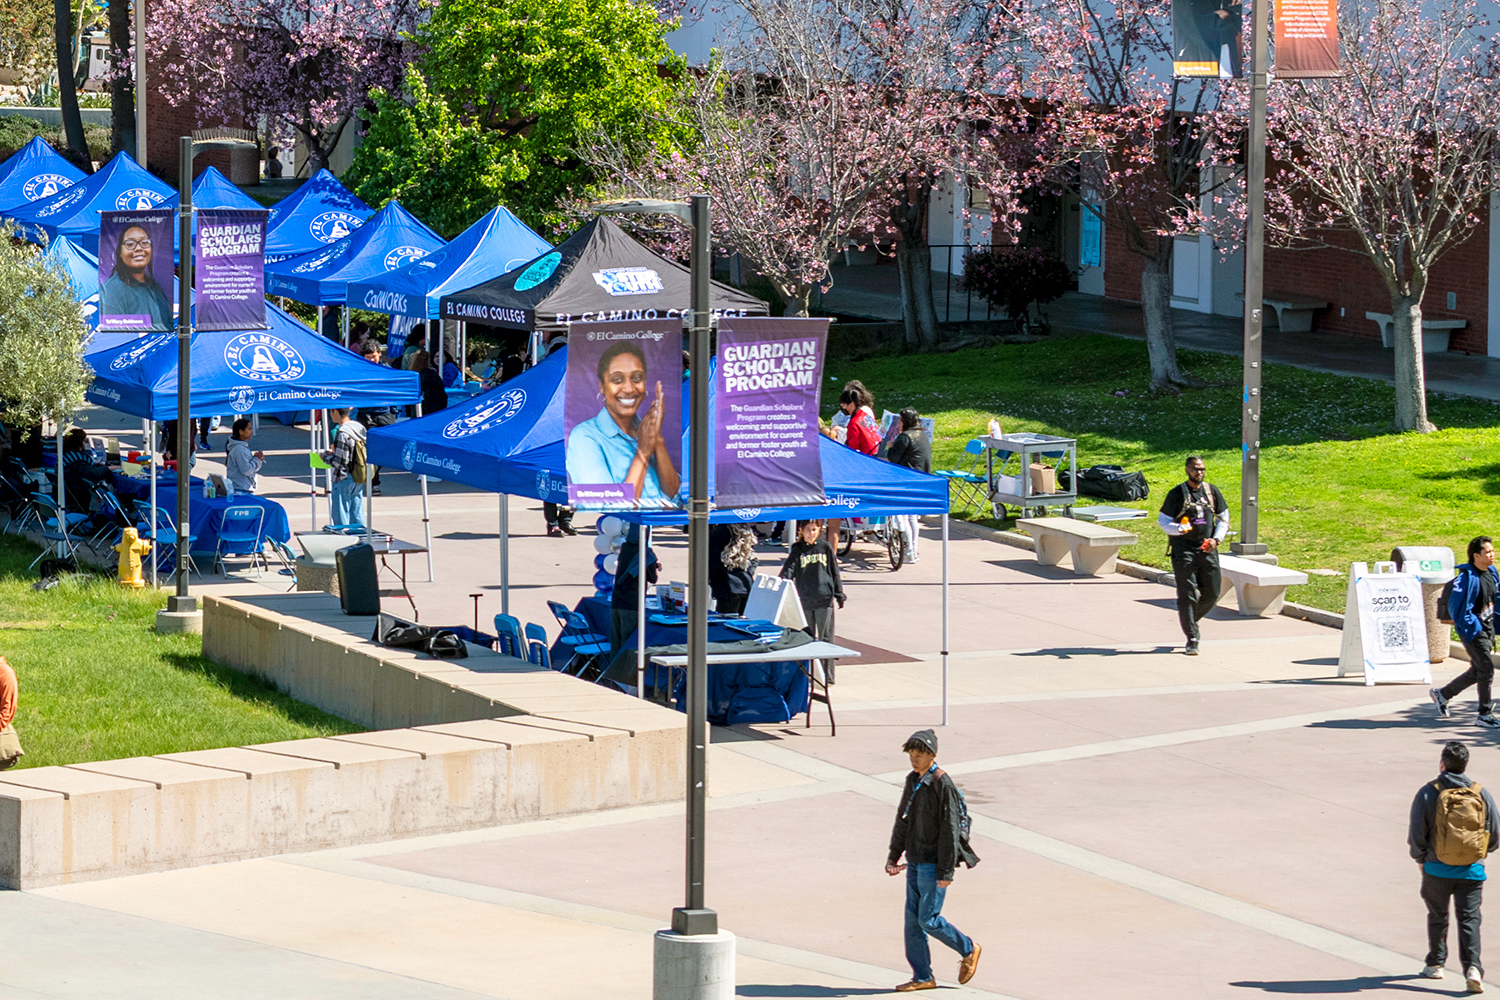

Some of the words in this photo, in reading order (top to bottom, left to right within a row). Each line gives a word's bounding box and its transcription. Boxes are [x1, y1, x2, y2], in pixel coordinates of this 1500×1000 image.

[201, 223, 261, 238] GUARDIAN
[200, 233, 261, 248] SCHOLARS
[202, 243, 260, 258] PROGRAM
[364, 290, 407, 313] CalWORKs
[447, 302, 455, 315] EL
[456, 303, 488, 319] CAMINO
[489, 306, 526, 323] COLLEGE
[556, 313, 573, 325] EL
[581, 309, 658, 324] CAMINO
[666, 308, 749, 319] COEGE
[596, 331, 605, 340] El
[605, 331, 636, 340] Camino
[636, 330, 664, 342] College
[228, 346, 239, 360] EL
[239, 334, 295, 358] CAMINO
[724, 341, 816, 362] GUARDIAN
[239, 365, 301, 380] COLLEGE
[722, 355, 817, 378] SCHOLARS
[725, 370, 813, 393] PROGRAM
[258, 392, 268, 401] El
[269, 390, 306, 401] Camino
[307, 388, 342, 400] College
[730, 404, 742, 412] The
[743, 404, 773, 412] Guardian
[736, 414, 766, 422] Program
[726, 423, 760, 431] welcoming
[773, 422, 807, 431] supportive
[729, 432, 769, 440] environment
[780, 431, 803, 439] current
[738, 441, 760, 449] former
[761, 441, 779, 449] foster
[780, 440, 800, 449] youth
[737, 450, 743, 458] El
[744, 450, 769, 458] Camino
[769, 450, 796, 459] College.
[416, 452, 422, 462] El
[422, 454, 442, 467] Camino
[442, 458, 462, 475] College
[604, 490, 624, 498] Davis
[1372, 596, 1397, 605] scan
[1399, 595, 1410, 604] to
